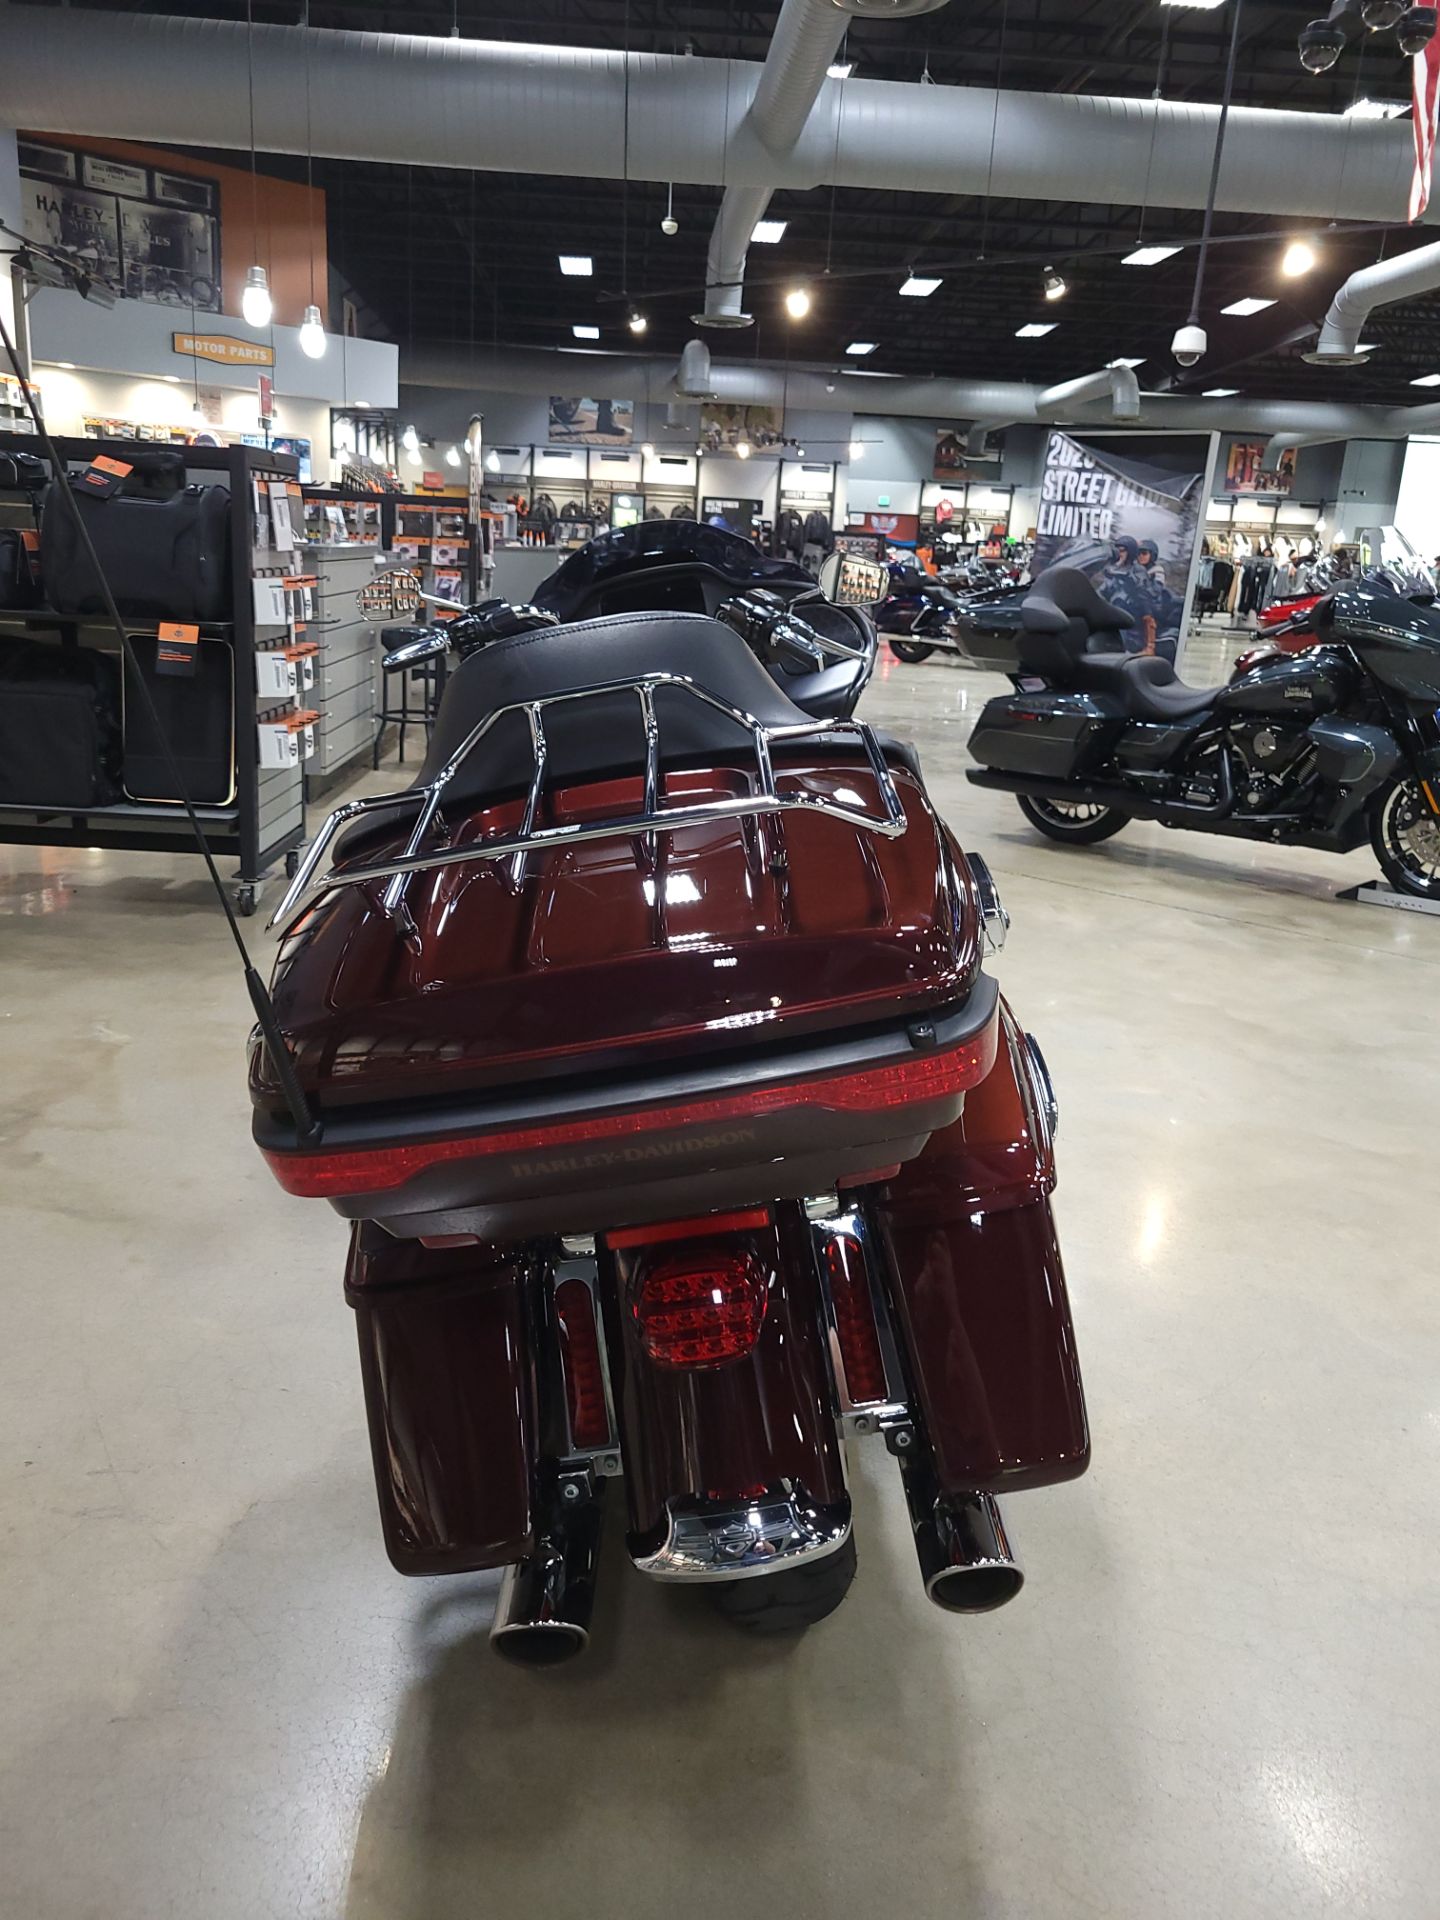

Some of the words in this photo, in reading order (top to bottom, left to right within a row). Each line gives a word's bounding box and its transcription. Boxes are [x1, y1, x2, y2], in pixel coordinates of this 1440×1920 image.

[183, 338, 226, 355] MOTOR
[229, 346, 268, 361] PARTS
[1042, 470, 1114, 505] STREET
[1036, 504, 1114, 540] LIMITED
[510, 1128, 756, 1178] HARLEY-DAVIDSON
